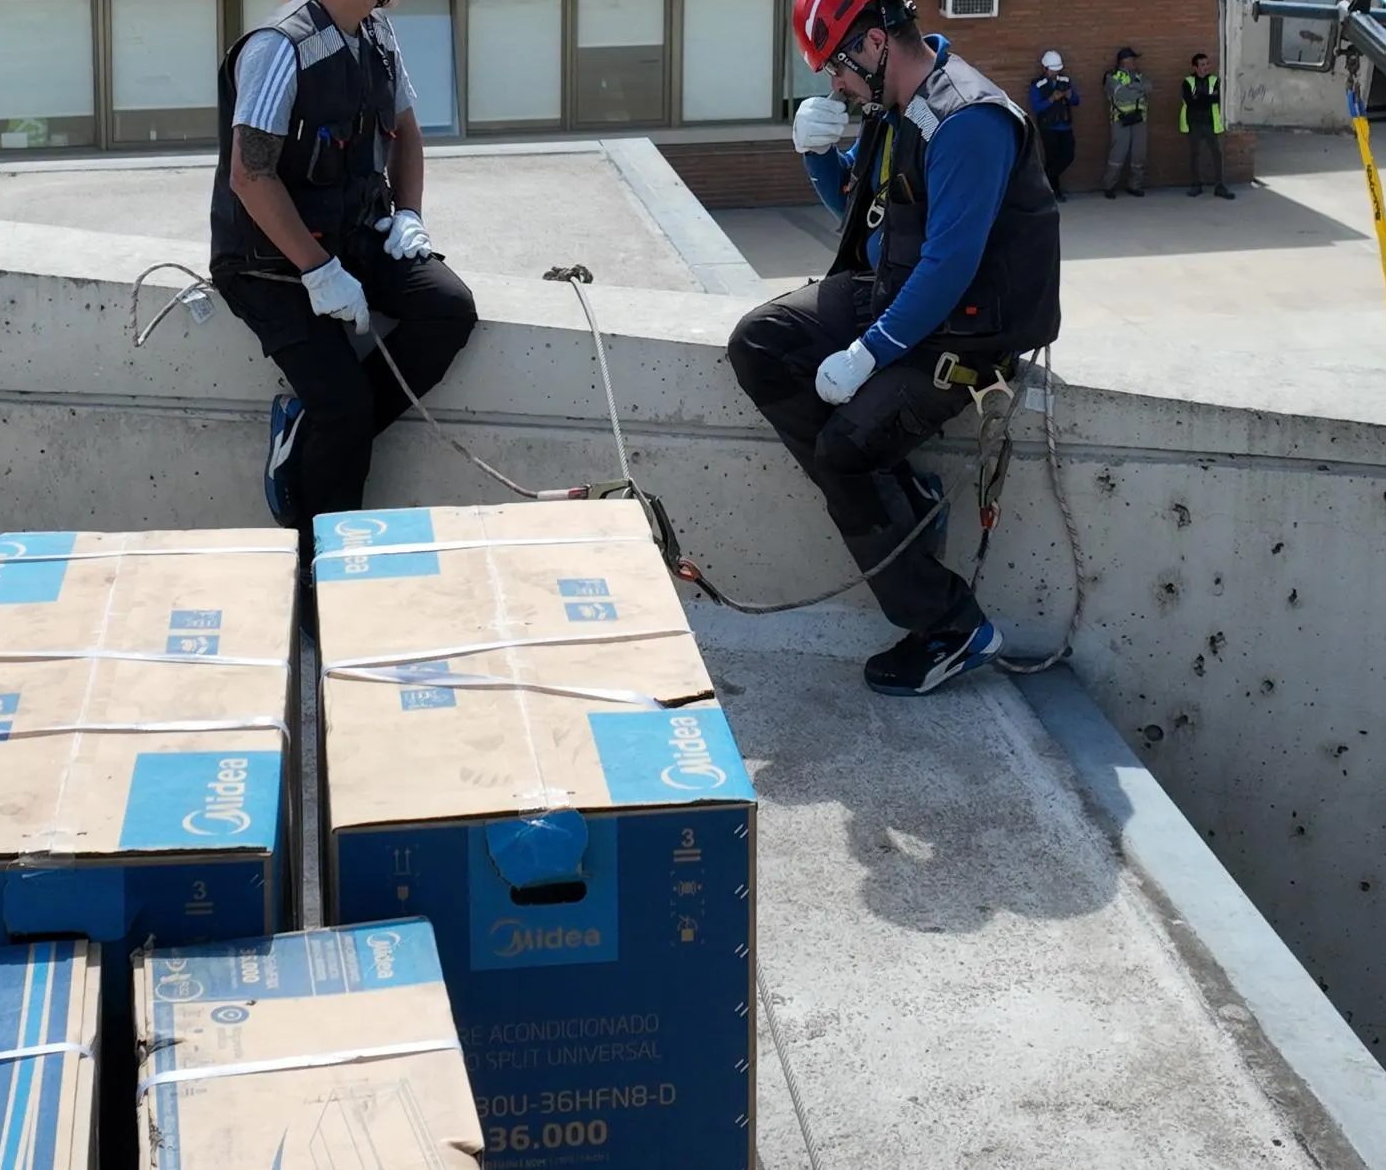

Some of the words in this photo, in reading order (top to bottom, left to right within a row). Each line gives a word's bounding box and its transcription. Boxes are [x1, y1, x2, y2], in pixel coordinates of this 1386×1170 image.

[664, 717, 722, 787] Midea
[192, 758, 250, 833] Midea
[681, 829, 695, 847] 3
[193, 880, 207, 900] 3
[493, 920, 601, 956] Midea
[460, 1026, 482, 1046] RE
[489, 1014, 659, 1044] ACONDICIONADO
[485, 1048, 541, 1071] SPLIT
[547, 1041, 662, 1066] UNIVERSAL
[476, 1083, 676, 1119] 30U-36HFN8-D
[489, 1119, 608, 1153] 36.000
